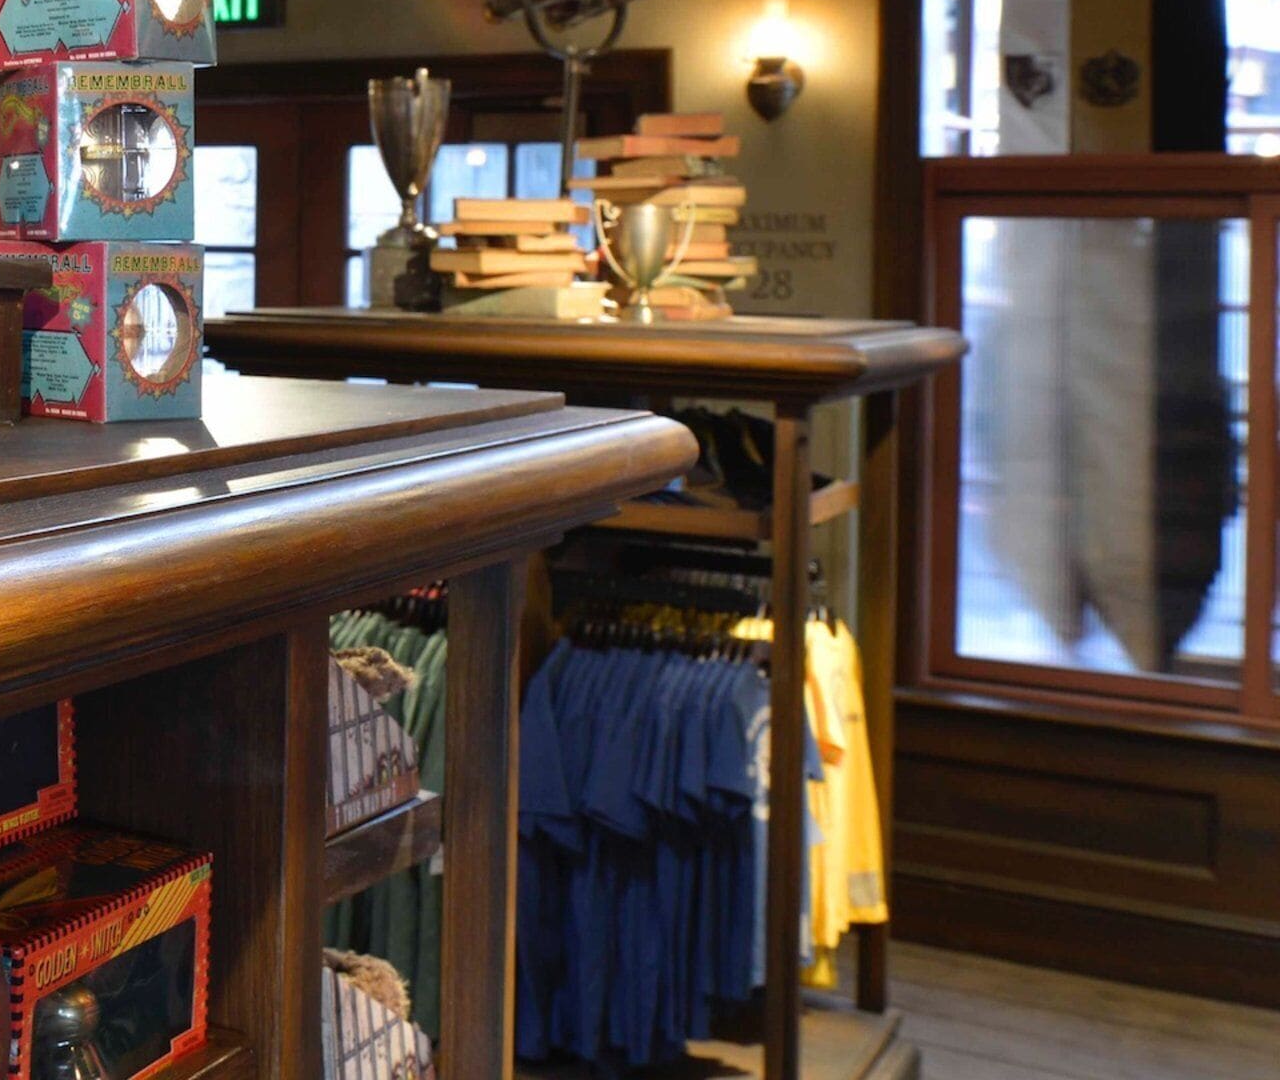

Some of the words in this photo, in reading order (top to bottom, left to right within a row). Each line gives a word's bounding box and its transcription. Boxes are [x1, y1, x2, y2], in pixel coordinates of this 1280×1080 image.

[69, 74, 188, 90] REMEMBRALL
[737, 212, 826, 229] AXIMUM
[113, 255, 202, 272] REMEMBRALL
[35, 942, 78, 990] GOLDEN
[90, 920, 124, 963] SNITCH
